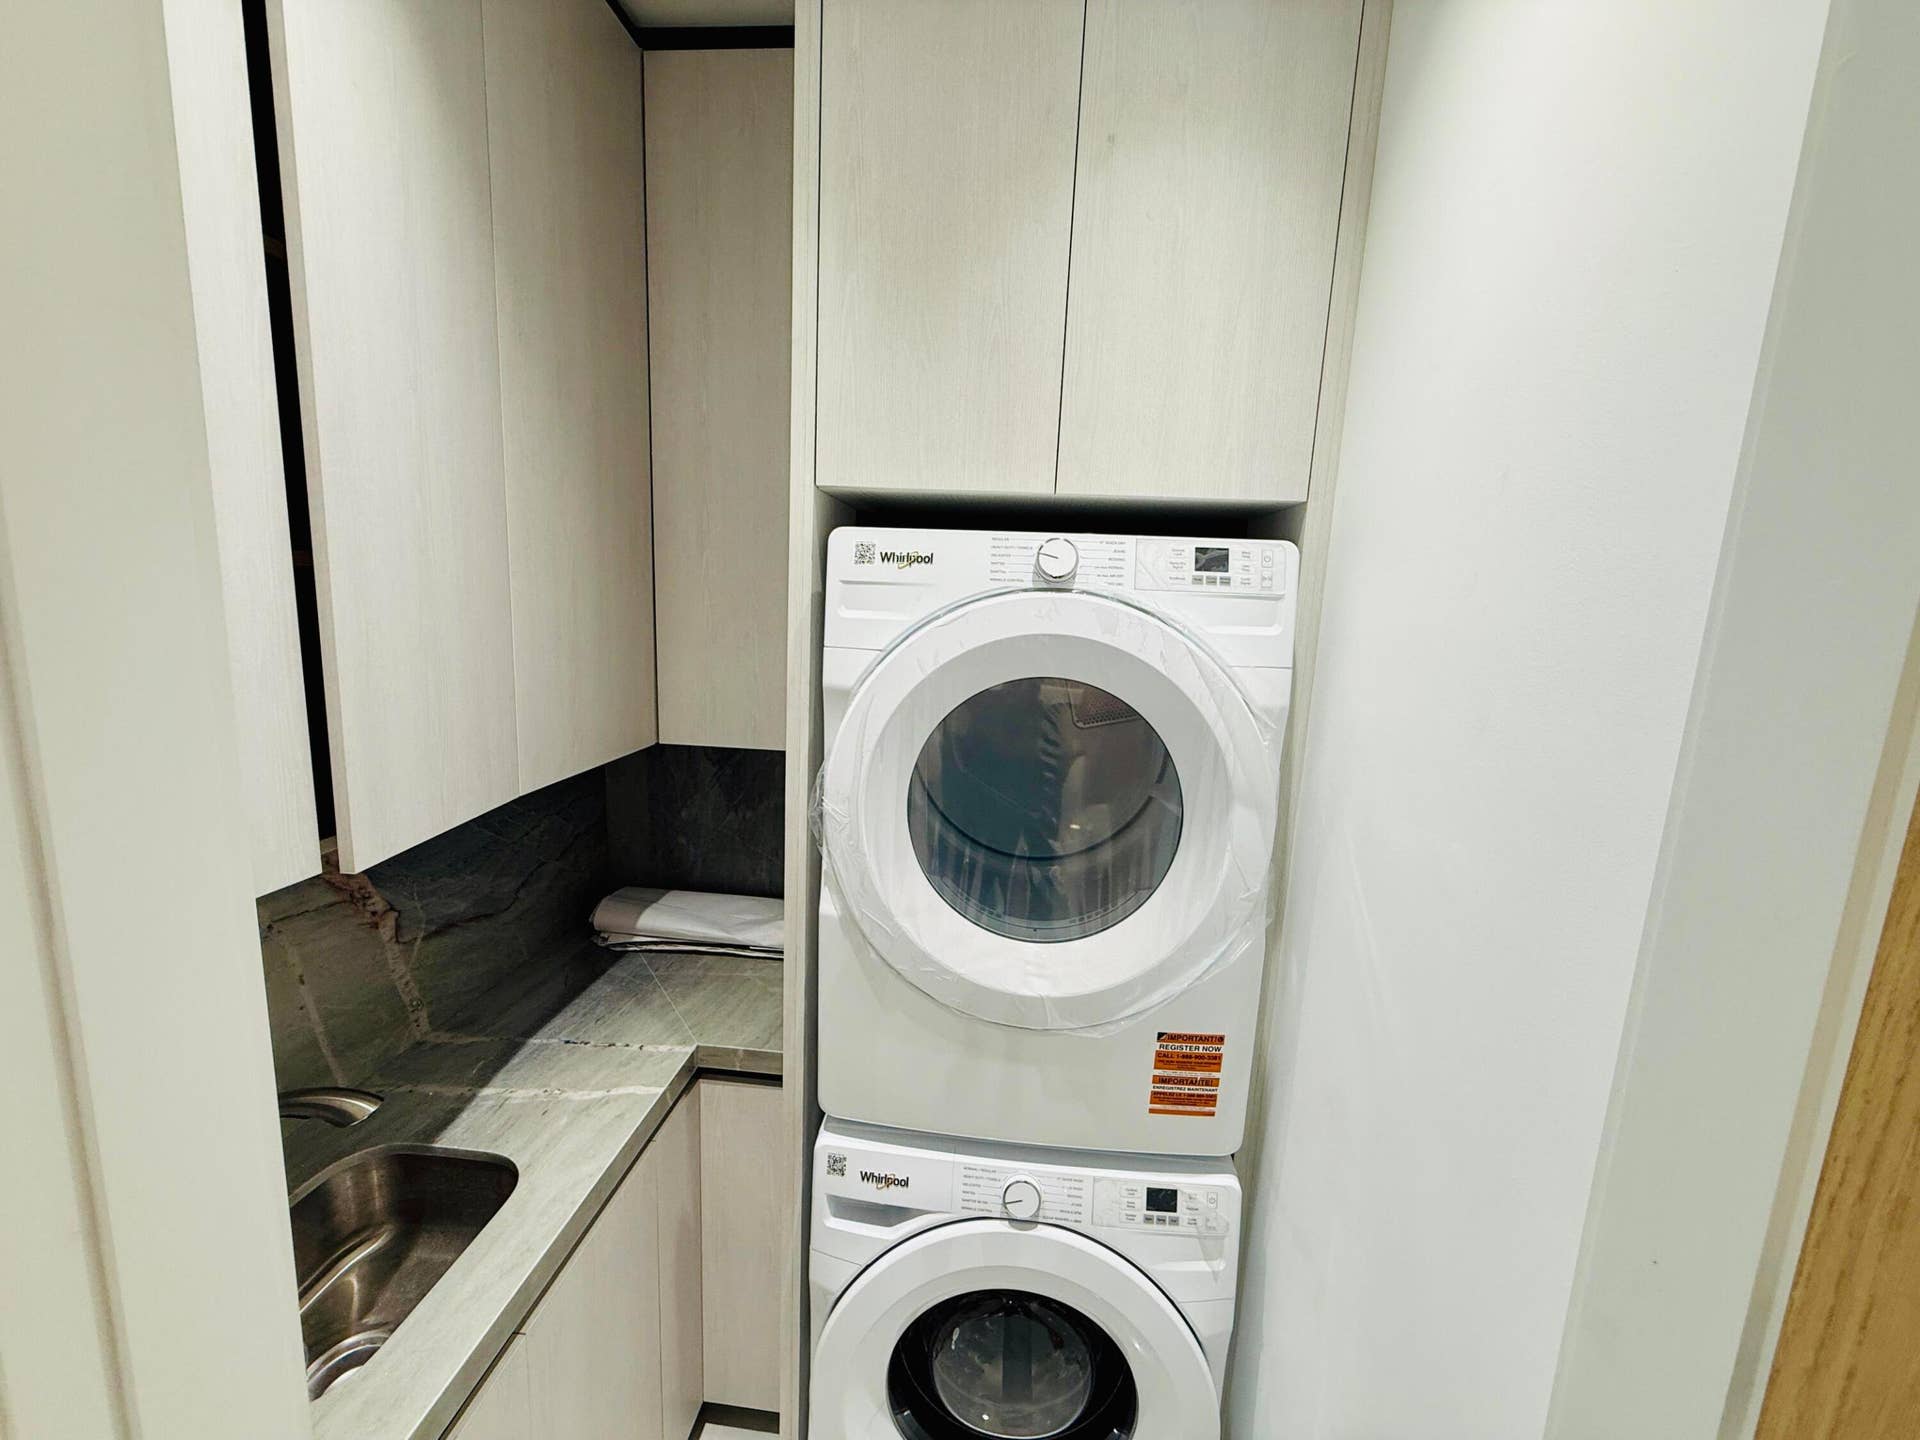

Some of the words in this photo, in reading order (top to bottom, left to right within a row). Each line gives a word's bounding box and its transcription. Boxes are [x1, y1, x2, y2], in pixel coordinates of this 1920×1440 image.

[880, 551, 934, 568] Whirlpool
[1159, 1044, 1201, 1052] REGISTER
[860, 1171, 909, 1189] Whirlpool
